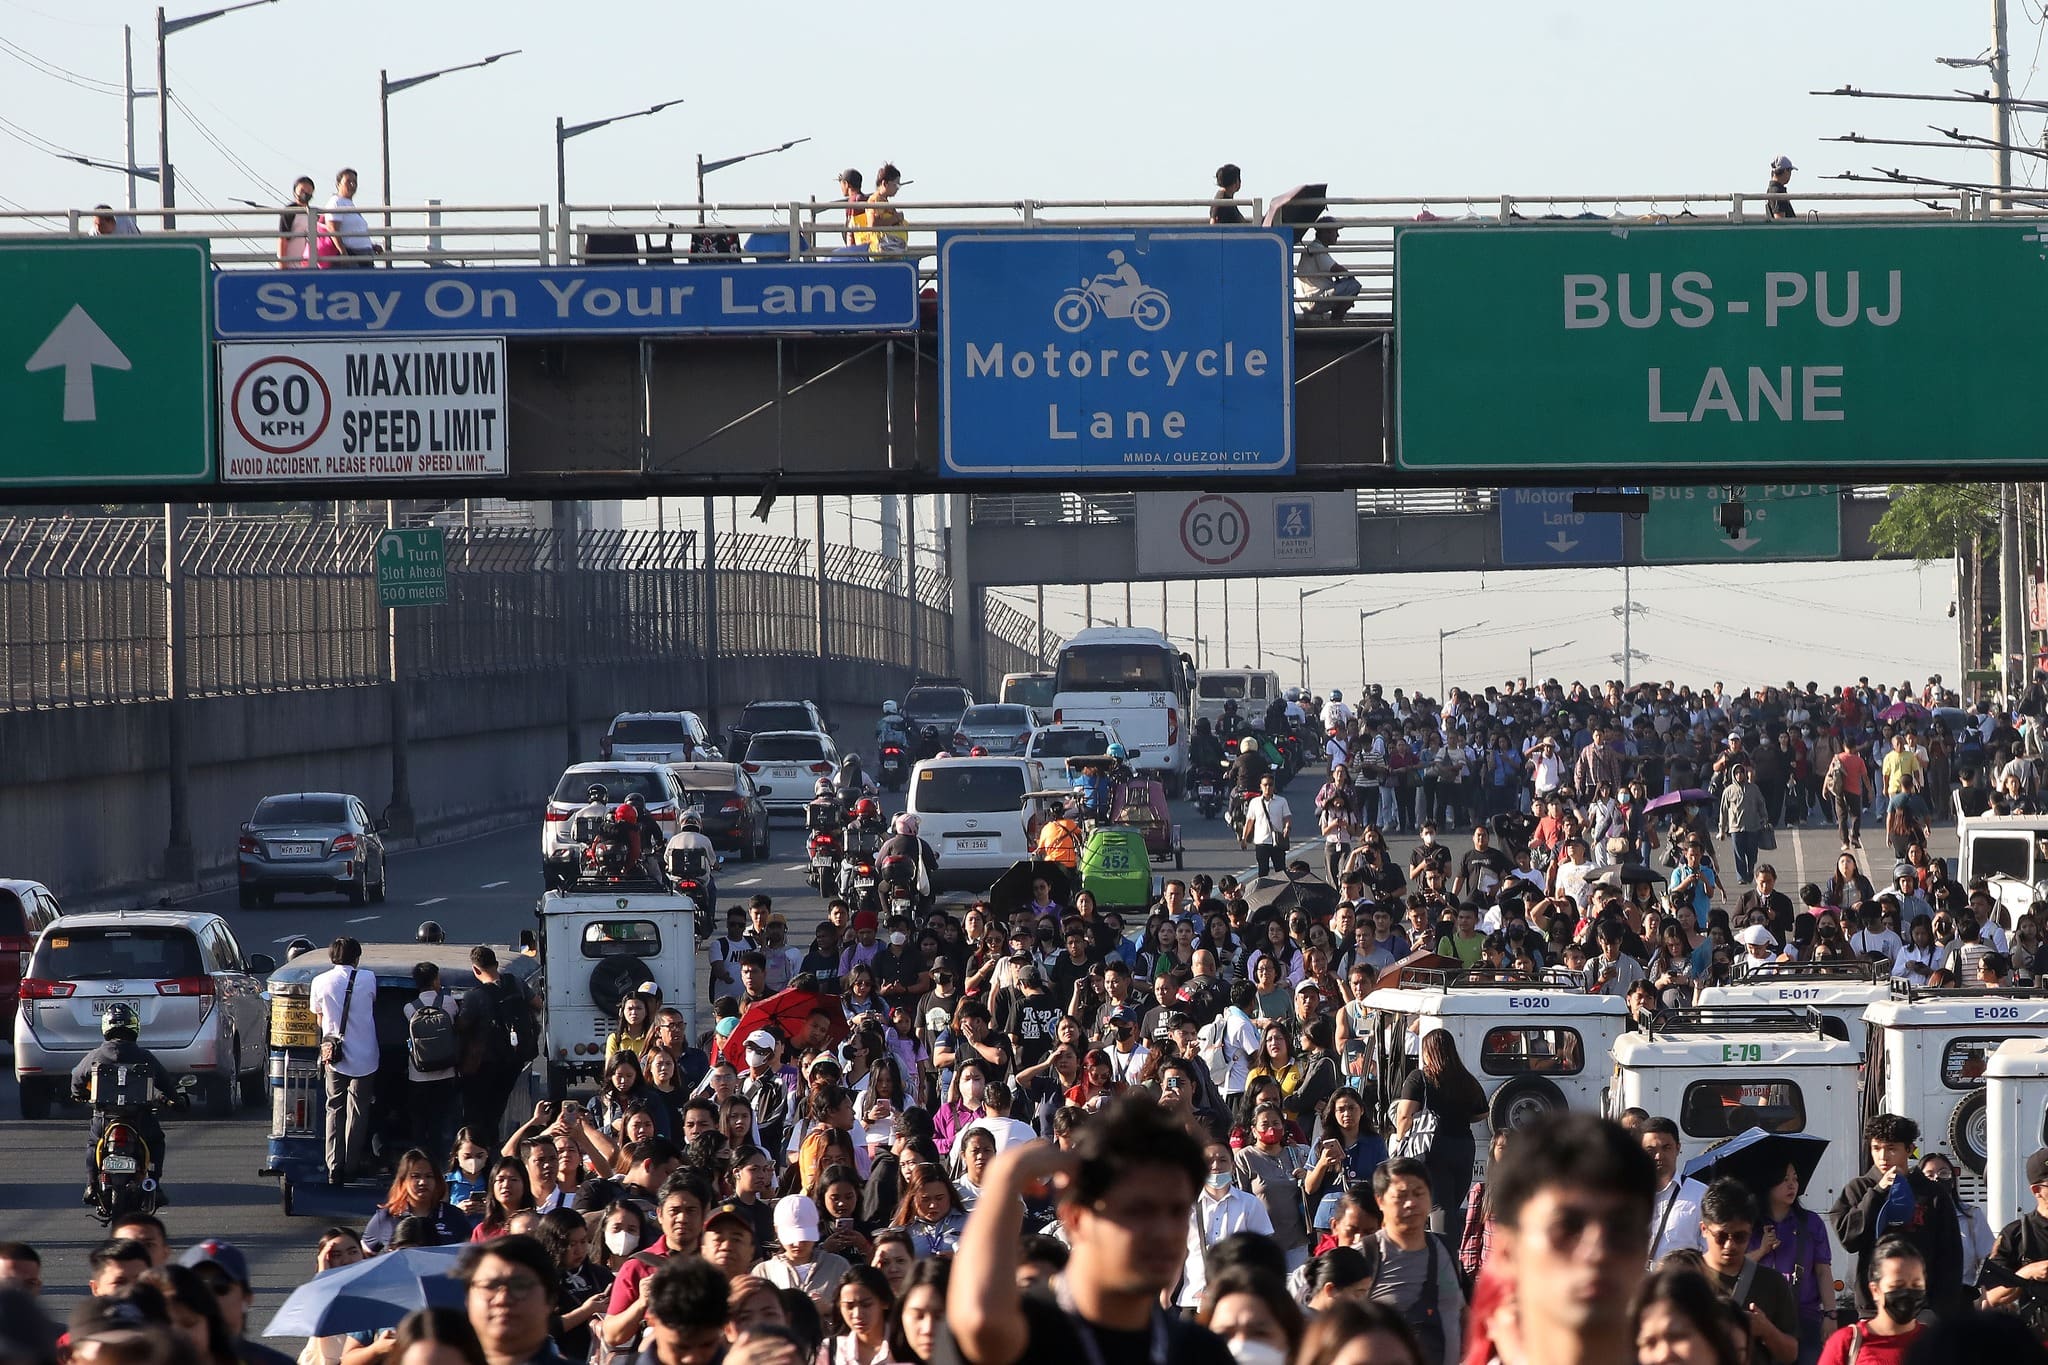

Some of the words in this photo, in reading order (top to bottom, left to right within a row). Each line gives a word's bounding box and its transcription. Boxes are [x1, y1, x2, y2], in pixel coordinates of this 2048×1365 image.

[256, 282, 400, 330] Stay
[424, 279, 517, 318] On
[538, 278, 695, 318] Your
[721, 277, 876, 314] Lane
[1563, 269, 1902, 329] BUS-PUJ
[966, 341, 1268, 386] Motorcycle
[345, 352, 496, 397] MAXIMUM
[252, 374, 310, 416] 60
[1647, 366, 1845, 422] LANE
[260, 421, 305, 435] KPH
[1049, 404, 1186, 440] Lane
[342, 409, 421, 454] SPEED
[429, 408, 496, 452] LIMIT
[1123, 454, 1162, 463] MMDA
[1164, 453, 1171, 463] /
[1173, 452, 1228, 463] QUEZON
[1232, 451, 1261, 462] CITY
[230, 459, 263, 475] AVOID
[266, 458, 322, 475] ACCIDENT.
[326, 456, 366, 473] PLEASE
[369, 456, 413, 473] FOLLOW
[418, 455, 453, 472] SPEED
[456, 455, 487, 472] LIMIT.
[1652, 486, 1695, 500] Bus
[1764, 485, 1828, 498] PUJs
[1543, 511, 1585, 525] Lane
[1713, 506, 1767, 521] Lne
[1191, 512, 1249, 546] 60
[418, 533, 427, 545] U
[408, 549, 438, 561] Turn
[382, 566, 405, 580] Slot
[409, 564, 443, 578] Ahead
[382, 587, 405, 600] 500
[409, 585, 444, 599] meters
[1103, 856, 1129, 868] 452
[1779, 989, 1820, 999] E-017
[1509, 998, 1550, 1008] E-020
[1974, 1007, 2019, 1018] E-026
[1722, 1044, 1762, 1061] E-79
